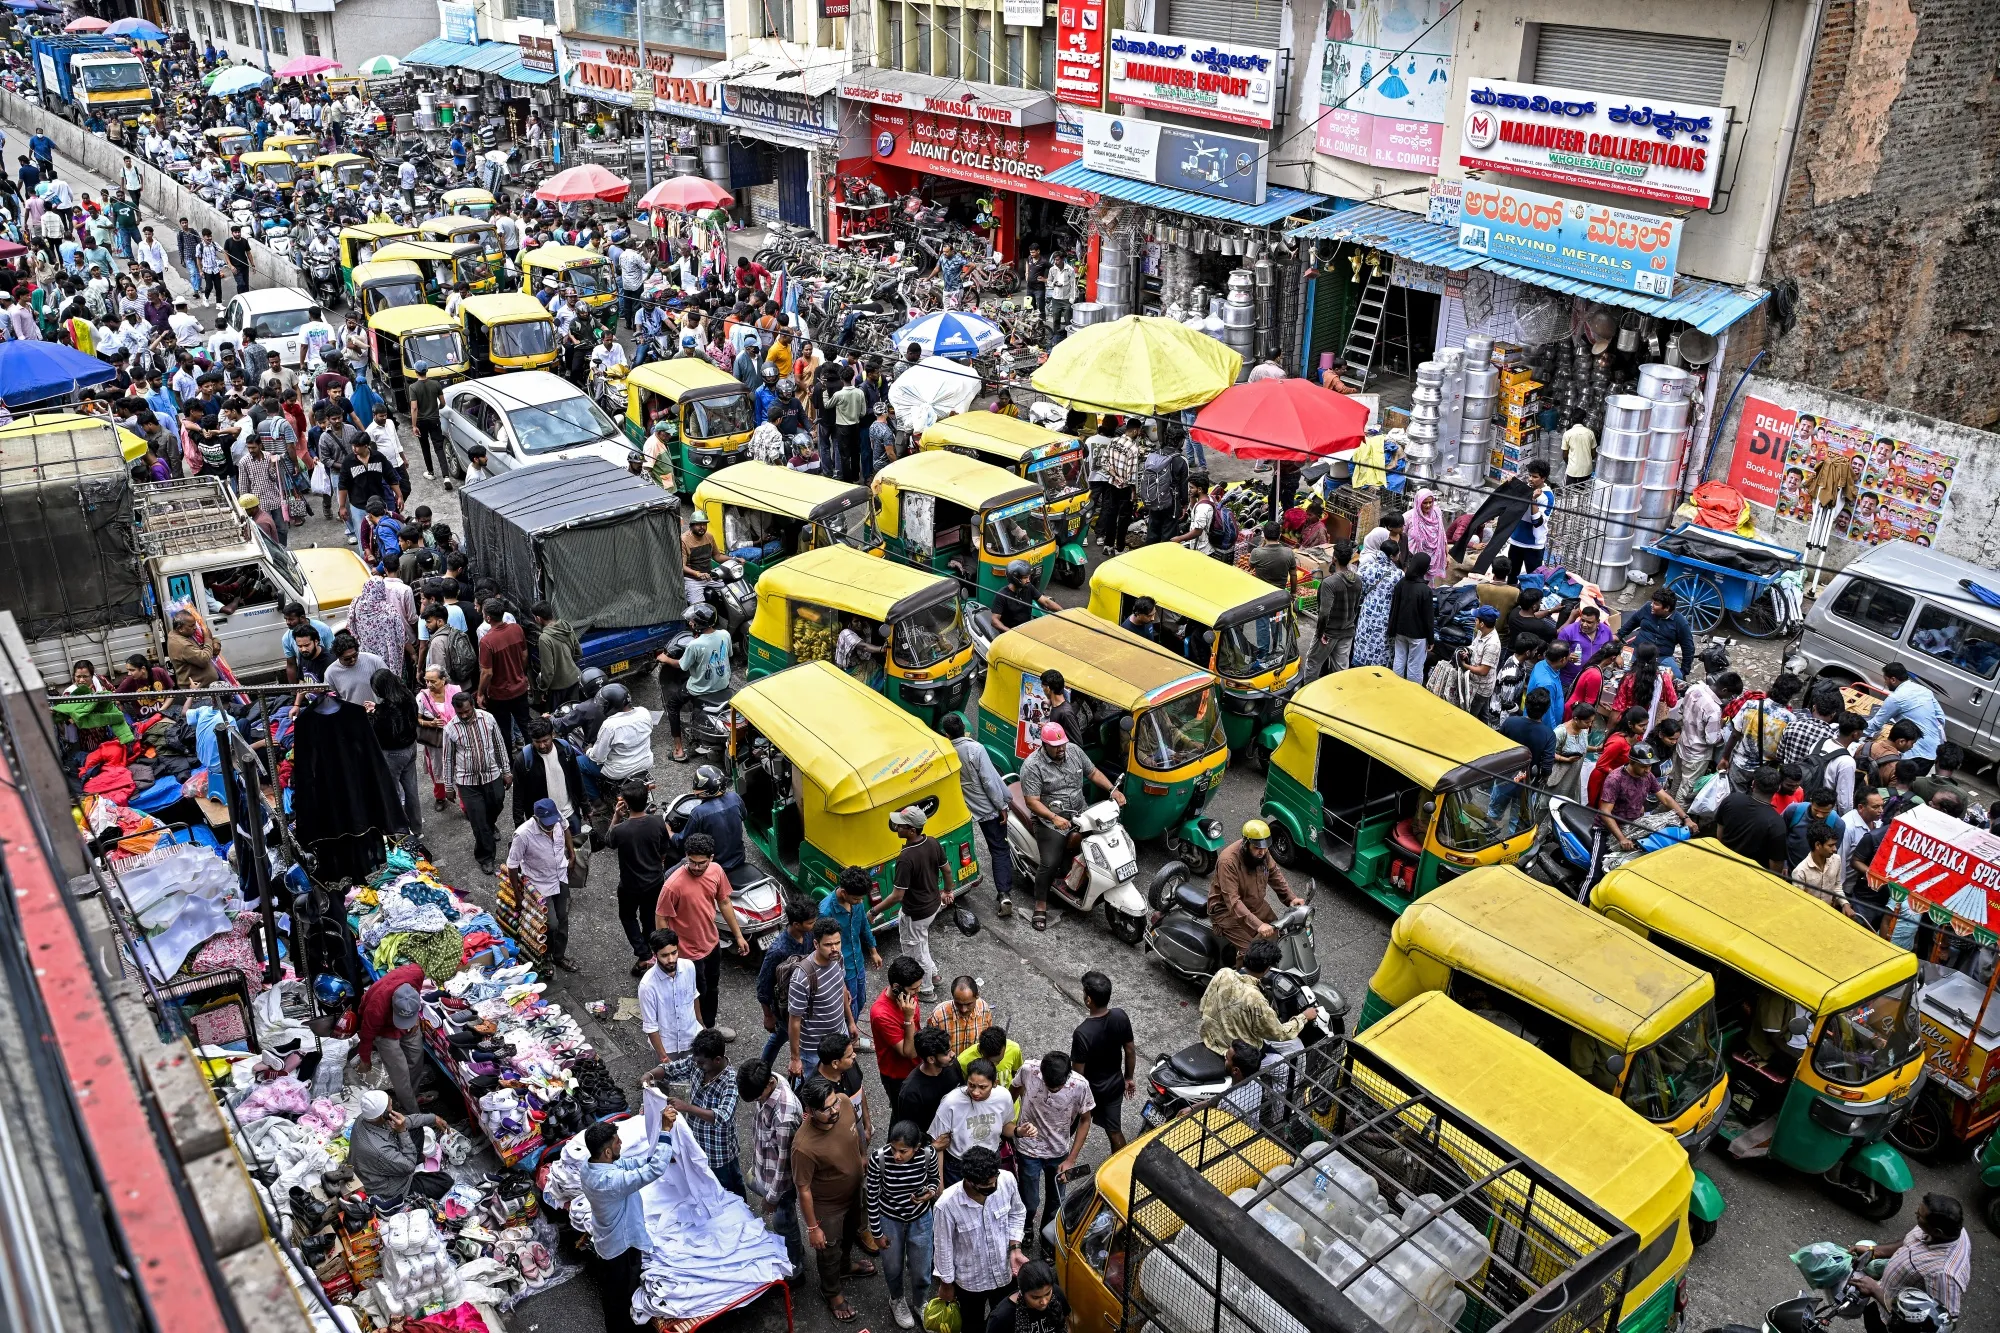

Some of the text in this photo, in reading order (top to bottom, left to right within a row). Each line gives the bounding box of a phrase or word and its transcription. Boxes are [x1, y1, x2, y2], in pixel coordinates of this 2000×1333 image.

[825, 4, 850, 14] STORES
[1111, 35, 1187, 60] ಮಹಾವೀರ್
[579, 62, 633, 93] INDIA
[653, 74, 712, 108] ETAL
[1126, 61, 1251, 98] MAHAVEER EXPORT
[741, 97, 775, 118] NISAR
[777, 104, 823, 128] METALS
[924, 97, 1013, 124] TANKASAL TOWER
[1470, 87, 1597, 118] ಮಹಾವೀರ್
[874, 113, 904, 125] Since 1955
[1105, 151, 1117, 159] HOME
[1117, 153, 1141, 164] APPLIANCES
[1319, 136, 1368, 158] R.K. COMPLEX
[1375, 149, 1394, 162] R.K.
[1498, 120, 1708, 173] MAHAVEER COLLECTIONS
[907, 141, 1043, 181] JAYANT CYCLE STORES
[1548, 153, 1613, 172] WHOLESALE
[1614, 162, 1647, 177] ONLY
[939, 165, 951, 174] Stop
[951, 167, 965, 176] Shop
[964, 170, 973, 178] For
[973, 171, 985, 180] Best
[985, 174, 1007, 186] Bicycles
[1493, 163, 1513, 172] Complex,
[1520, 167, 1532, 175] Floor,
[1552, 172, 1565, 180] Street
[1565, 175, 1577, 183] (Opp
[1577, 177, 1597, 187] Chickpet
[1597, 180, 1610, 188] Metro
[1611, 182, 1627, 190] Station
[1627, 185, 1639, 193] Gate
[1647, 188, 1670, 199] Bengaluru
[1675, 194, 1695, 203] 560053.
[1464, 187, 1673, 270] ಅರವಿಂದ್ ಮೆಟಲ್ಸ್
[1493, 232, 1633, 271] ARVIND METALS
[906, 336, 932, 344] ORBIT
[975, 329, 992, 342] ORBIT
[1755, 413, 1794, 437] DELHI
[1745, 461, 1766, 475] Book
[1767, 469, 1773, 477] a
[1741, 477, 1774, 494] Download
[1893, 825, 1969, 875] KARNATAKA
